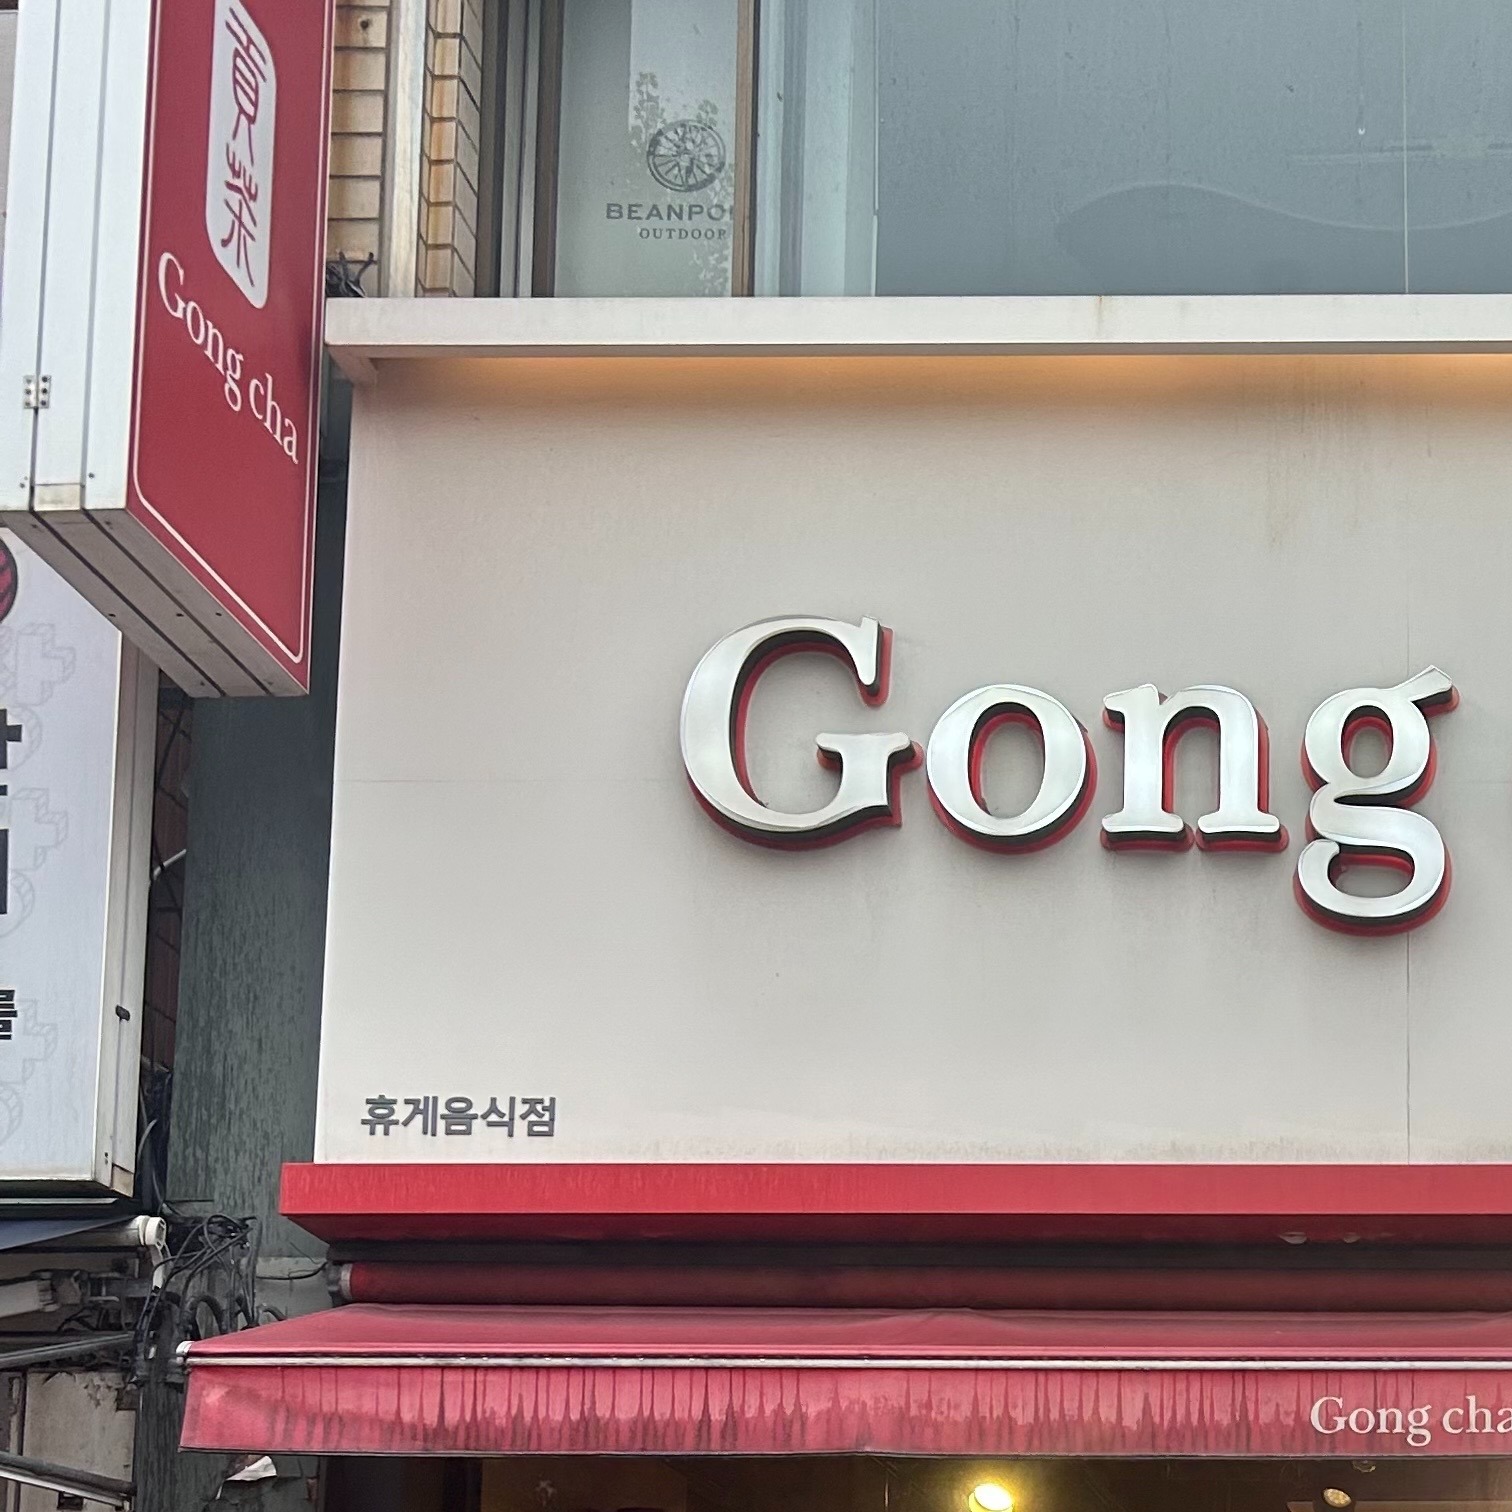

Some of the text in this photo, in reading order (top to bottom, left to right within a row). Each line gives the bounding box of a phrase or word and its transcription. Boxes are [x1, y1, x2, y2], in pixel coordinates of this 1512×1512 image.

[157, 251, 299, 465] Gong cha
[680, 614, 1459, 938] Gong
[360, 1094, 557, 1137] 휴게음식점
[1310, 1396, 1432, 1447] Gong
